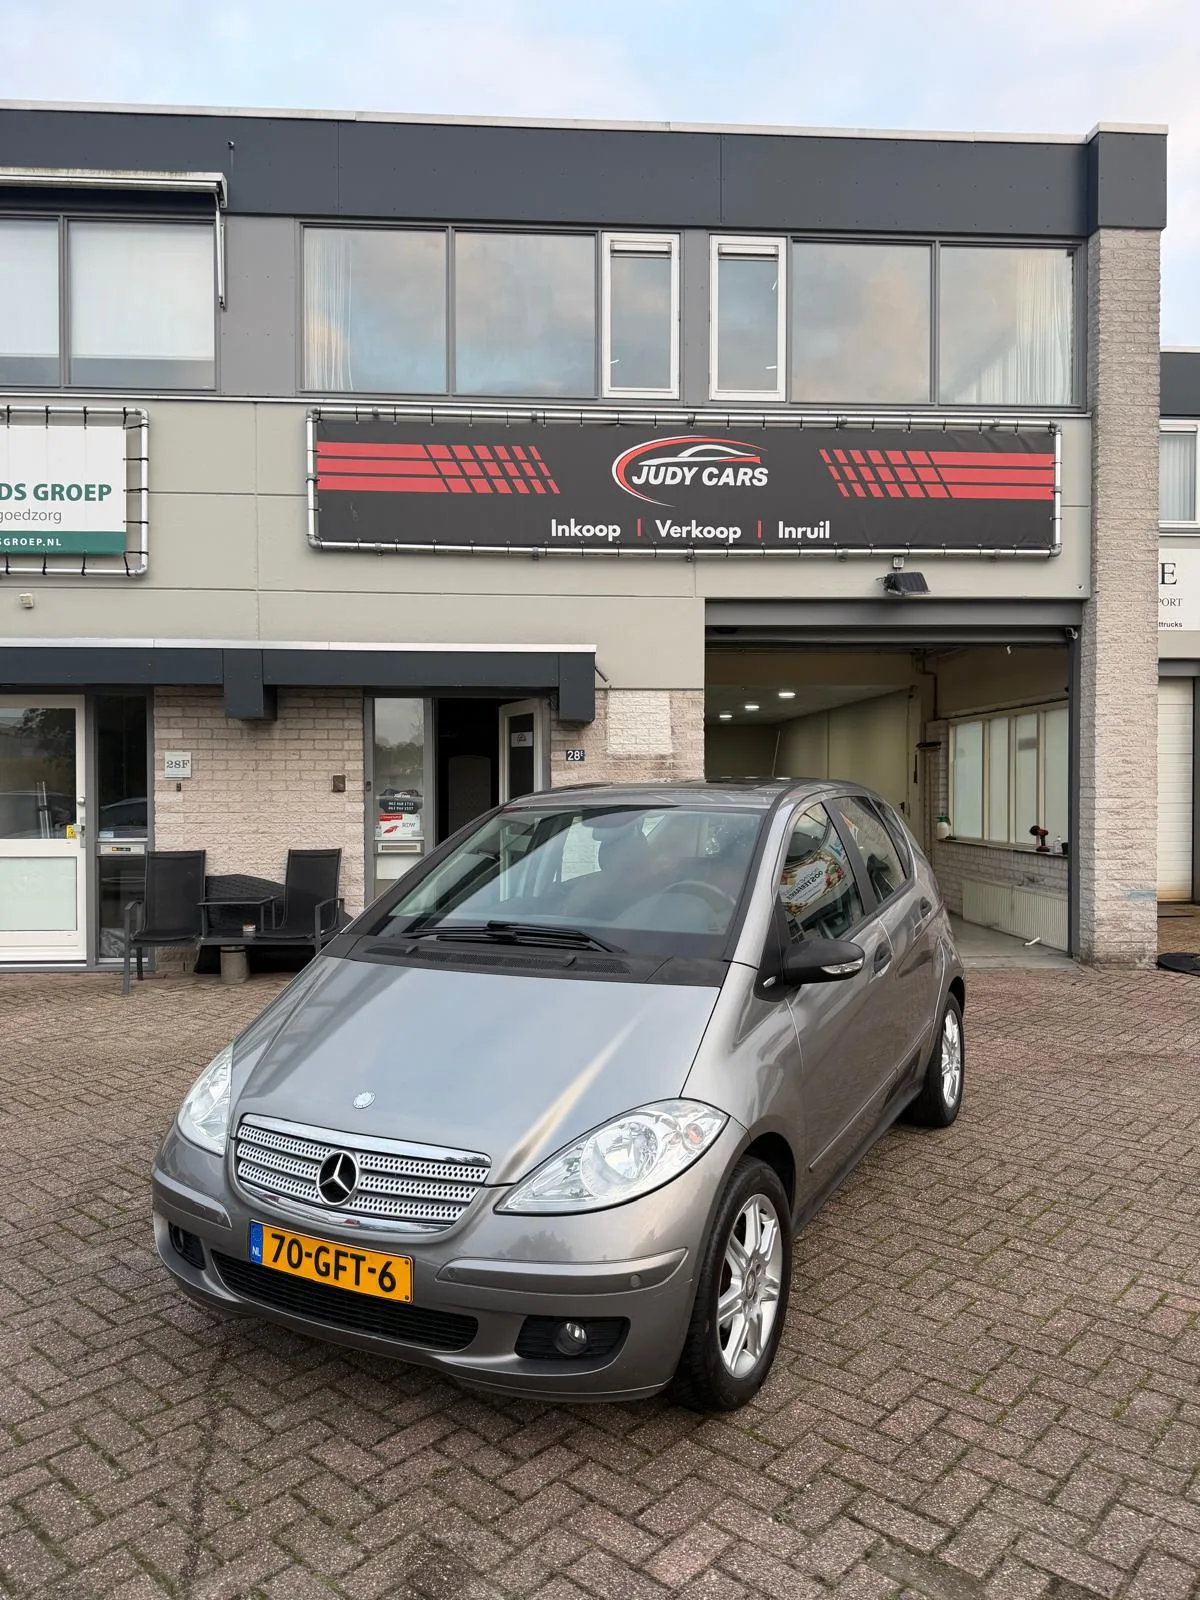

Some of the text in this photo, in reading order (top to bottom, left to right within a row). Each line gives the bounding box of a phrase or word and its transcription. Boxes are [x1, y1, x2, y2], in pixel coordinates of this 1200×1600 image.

[632, 466, 768, 486] JUDY CARS
[33, 484, 112, 501] GROEP
[551, 519, 830, 543] Inkoop Verkoop Inruil
[1159, 563, 1177, 585] E
[166, 759, 190, 769] 28F
[252, 1246, 262, 1257] NL
[271, 1233, 396, 1293] 70-GFT-6
